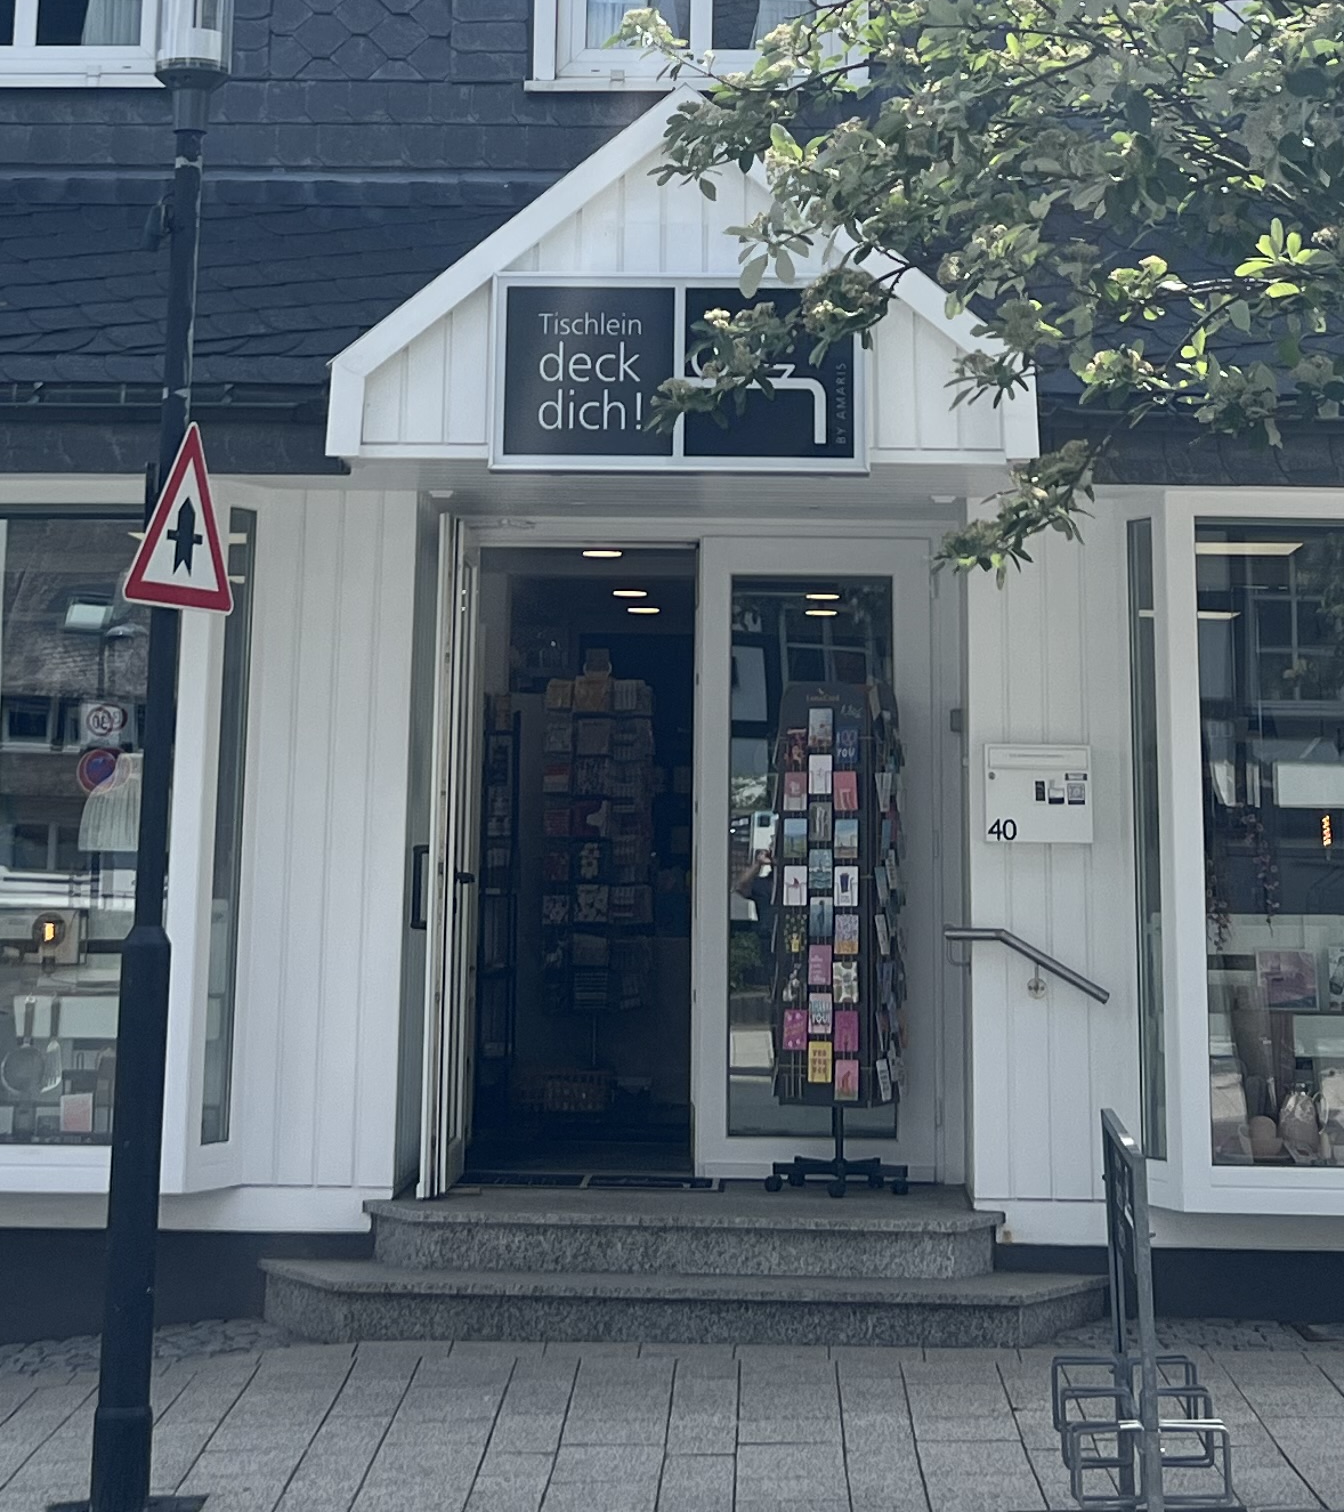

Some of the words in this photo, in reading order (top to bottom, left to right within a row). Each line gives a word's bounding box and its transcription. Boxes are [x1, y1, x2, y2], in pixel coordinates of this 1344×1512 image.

[538, 311, 642, 336] Tischlein
[539, 340, 641, 383] deck
[835, 362, 848, 420] AMARIS
[538, 388, 642, 430] dich!
[835, 426, 847, 444] BY
[988, 818, 1017, 841] 40
